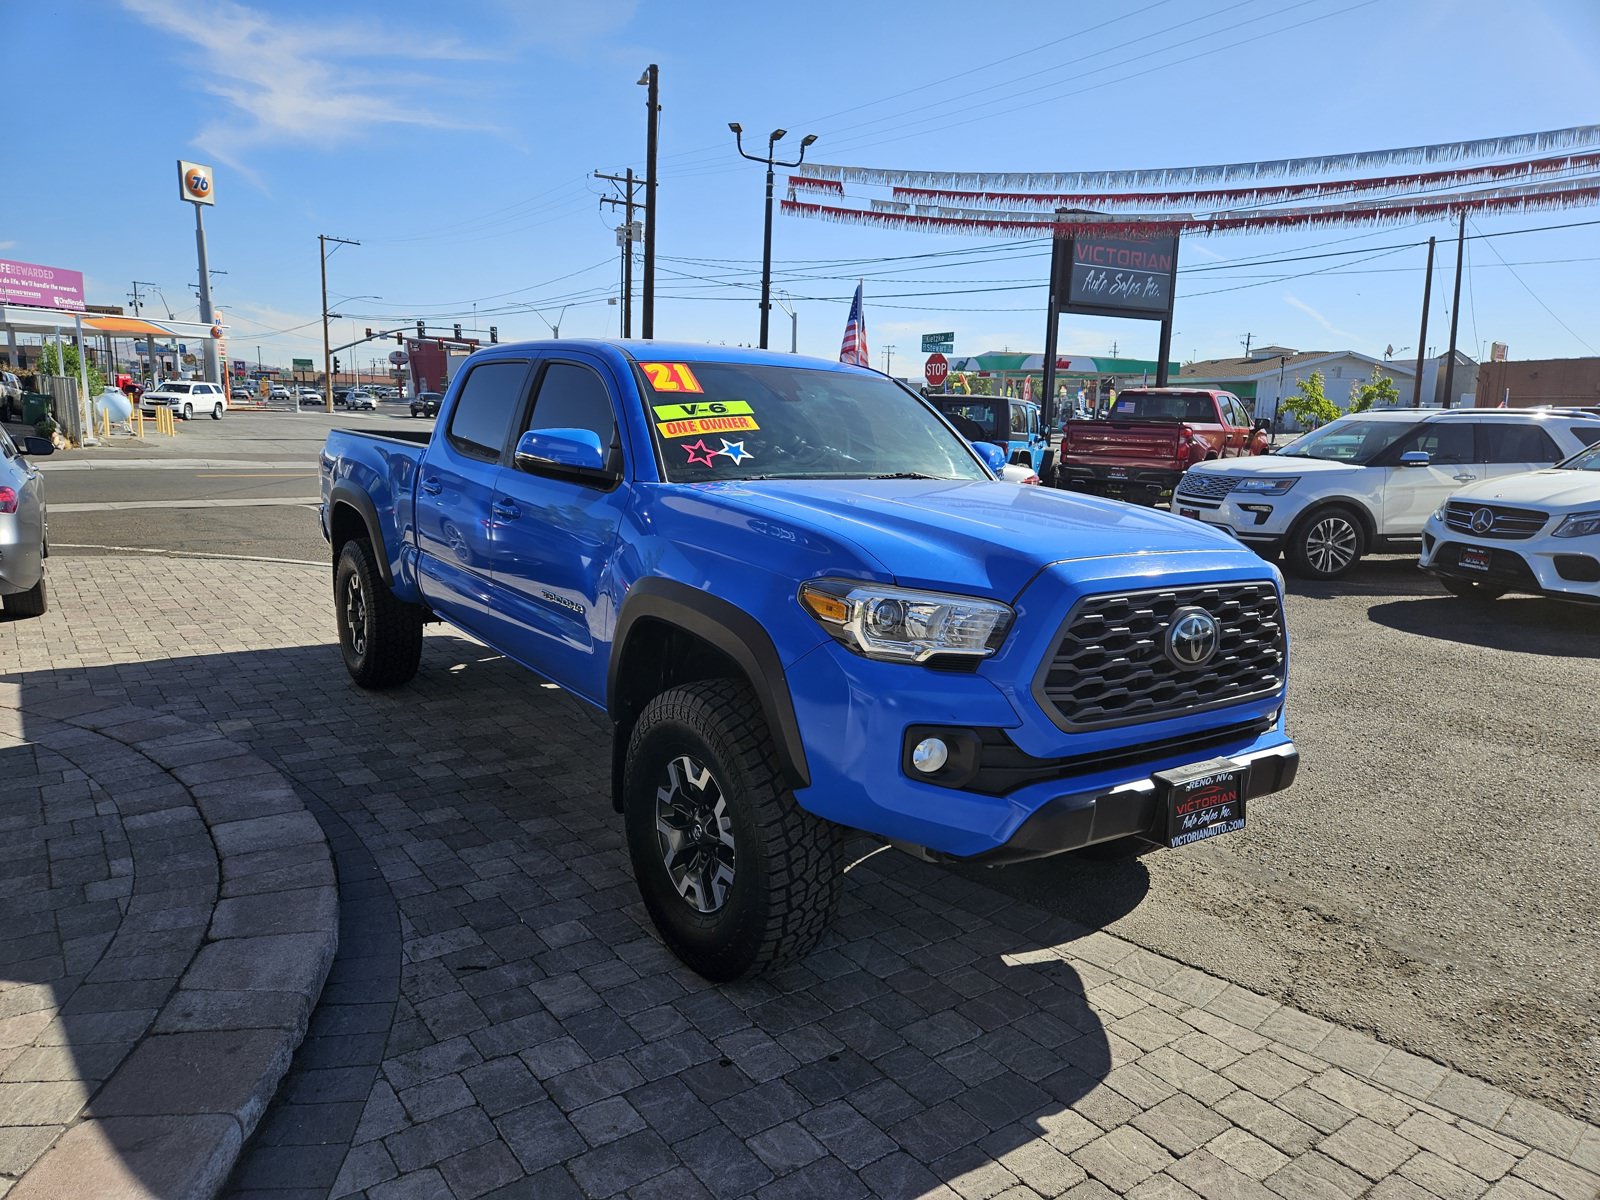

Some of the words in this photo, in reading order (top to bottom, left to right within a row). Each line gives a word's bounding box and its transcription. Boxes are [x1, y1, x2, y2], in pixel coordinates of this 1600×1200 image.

[192, 175, 209, 191] 76
[1076, 243, 1171, 271] VICTORIAN
[1081, 270, 1107, 292] Auto
[1109, 273, 1141, 299] Sales
[643, 363, 697, 390] 21
[926, 363, 947, 376] STOP
[680, 403, 727, 415] V-6
[666, 420, 697, 435] ONE
[699, 417, 749, 431] OWNER
[1189, 776, 1214, 790] RENO,
[1216, 773, 1228, 783] NV
[1176, 791, 1237, 815] VICTORIAN
[1181, 814, 1197, 830] Auto
[1197, 808, 1218, 827] Sales
[1219, 805, 1232, 820] Inc.
[1171, 818, 1245, 848] VICTORIANAUTO.COM
